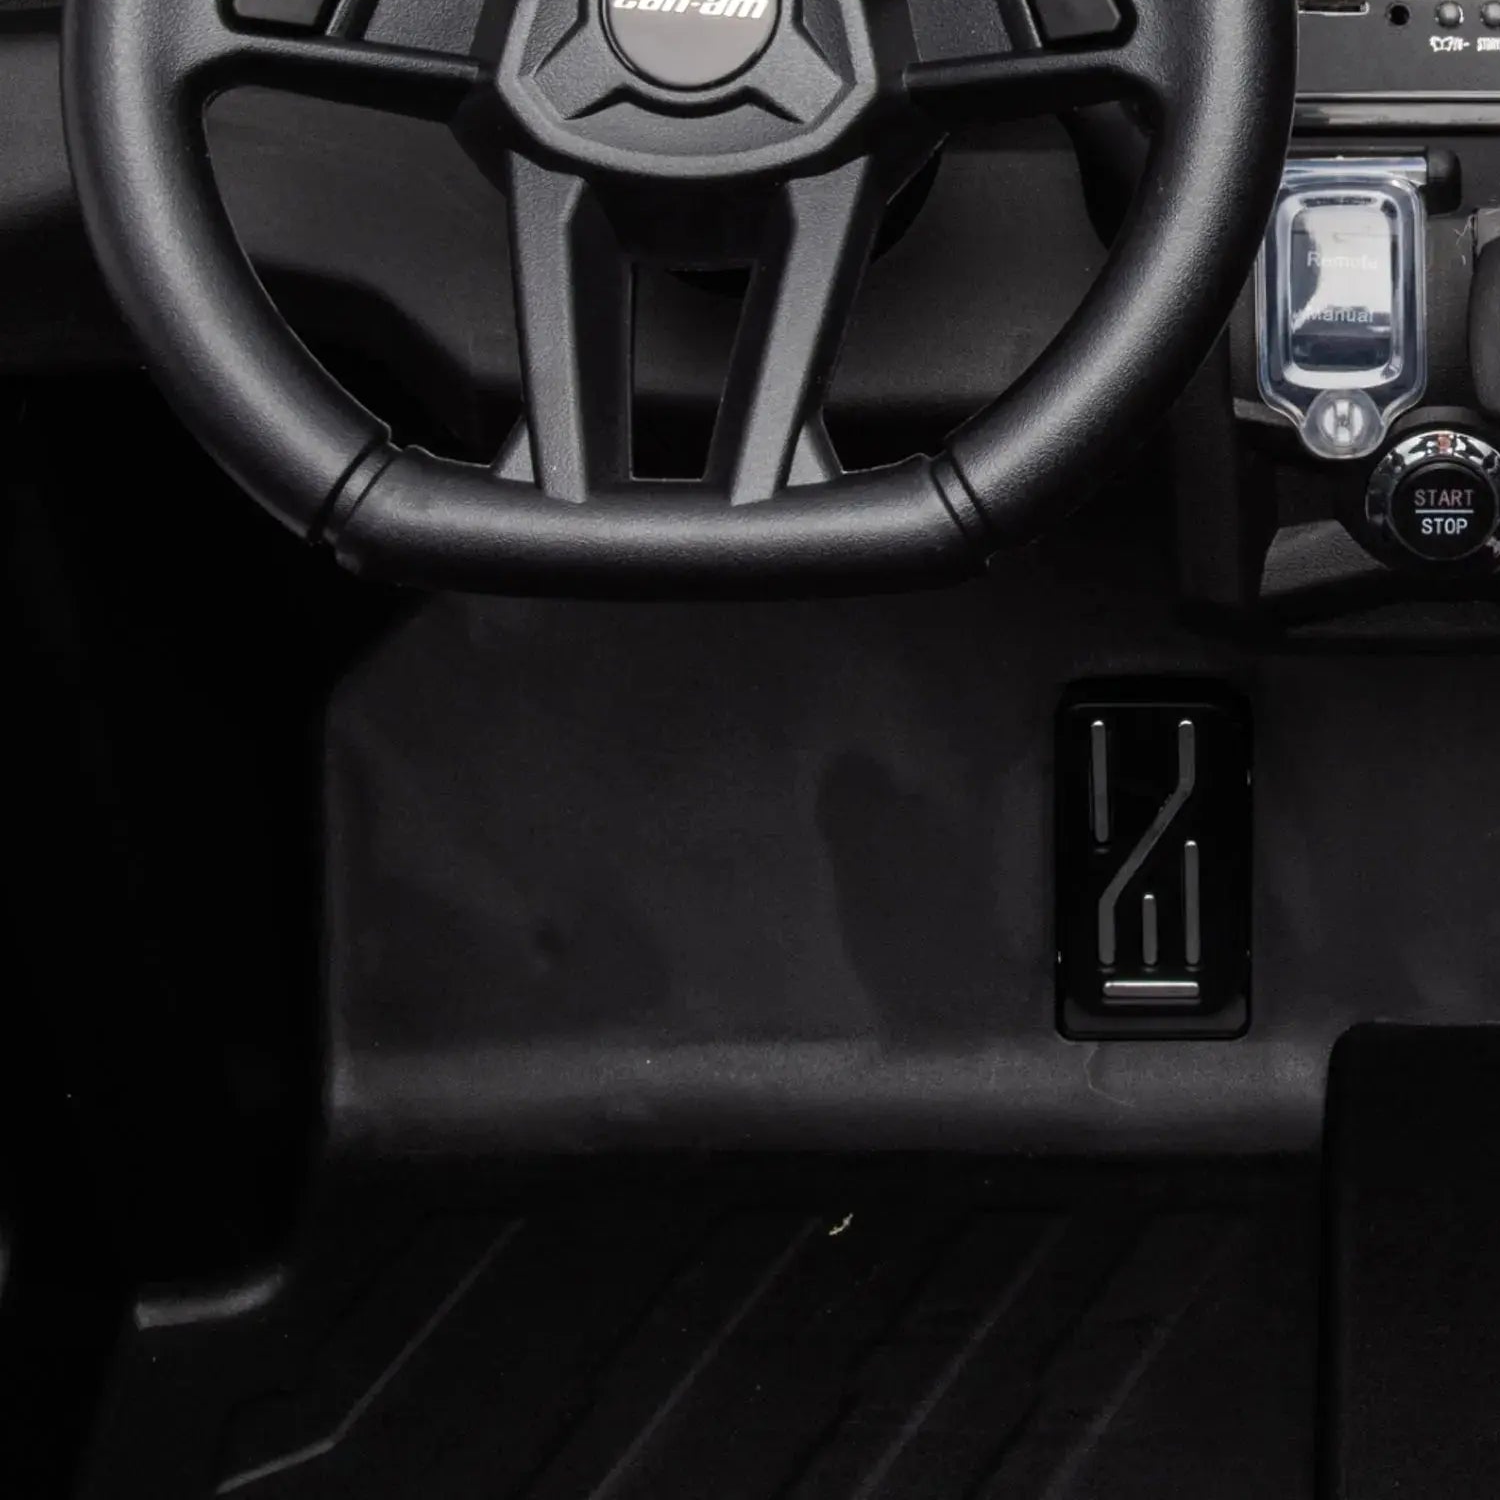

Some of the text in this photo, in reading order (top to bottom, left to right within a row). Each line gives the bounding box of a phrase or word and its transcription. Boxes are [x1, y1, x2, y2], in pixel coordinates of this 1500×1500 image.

[1306, 250, 1379, 269] Remote
[1414, 488, 1474, 507] START
[1421, 517, 1468, 535] STOP
